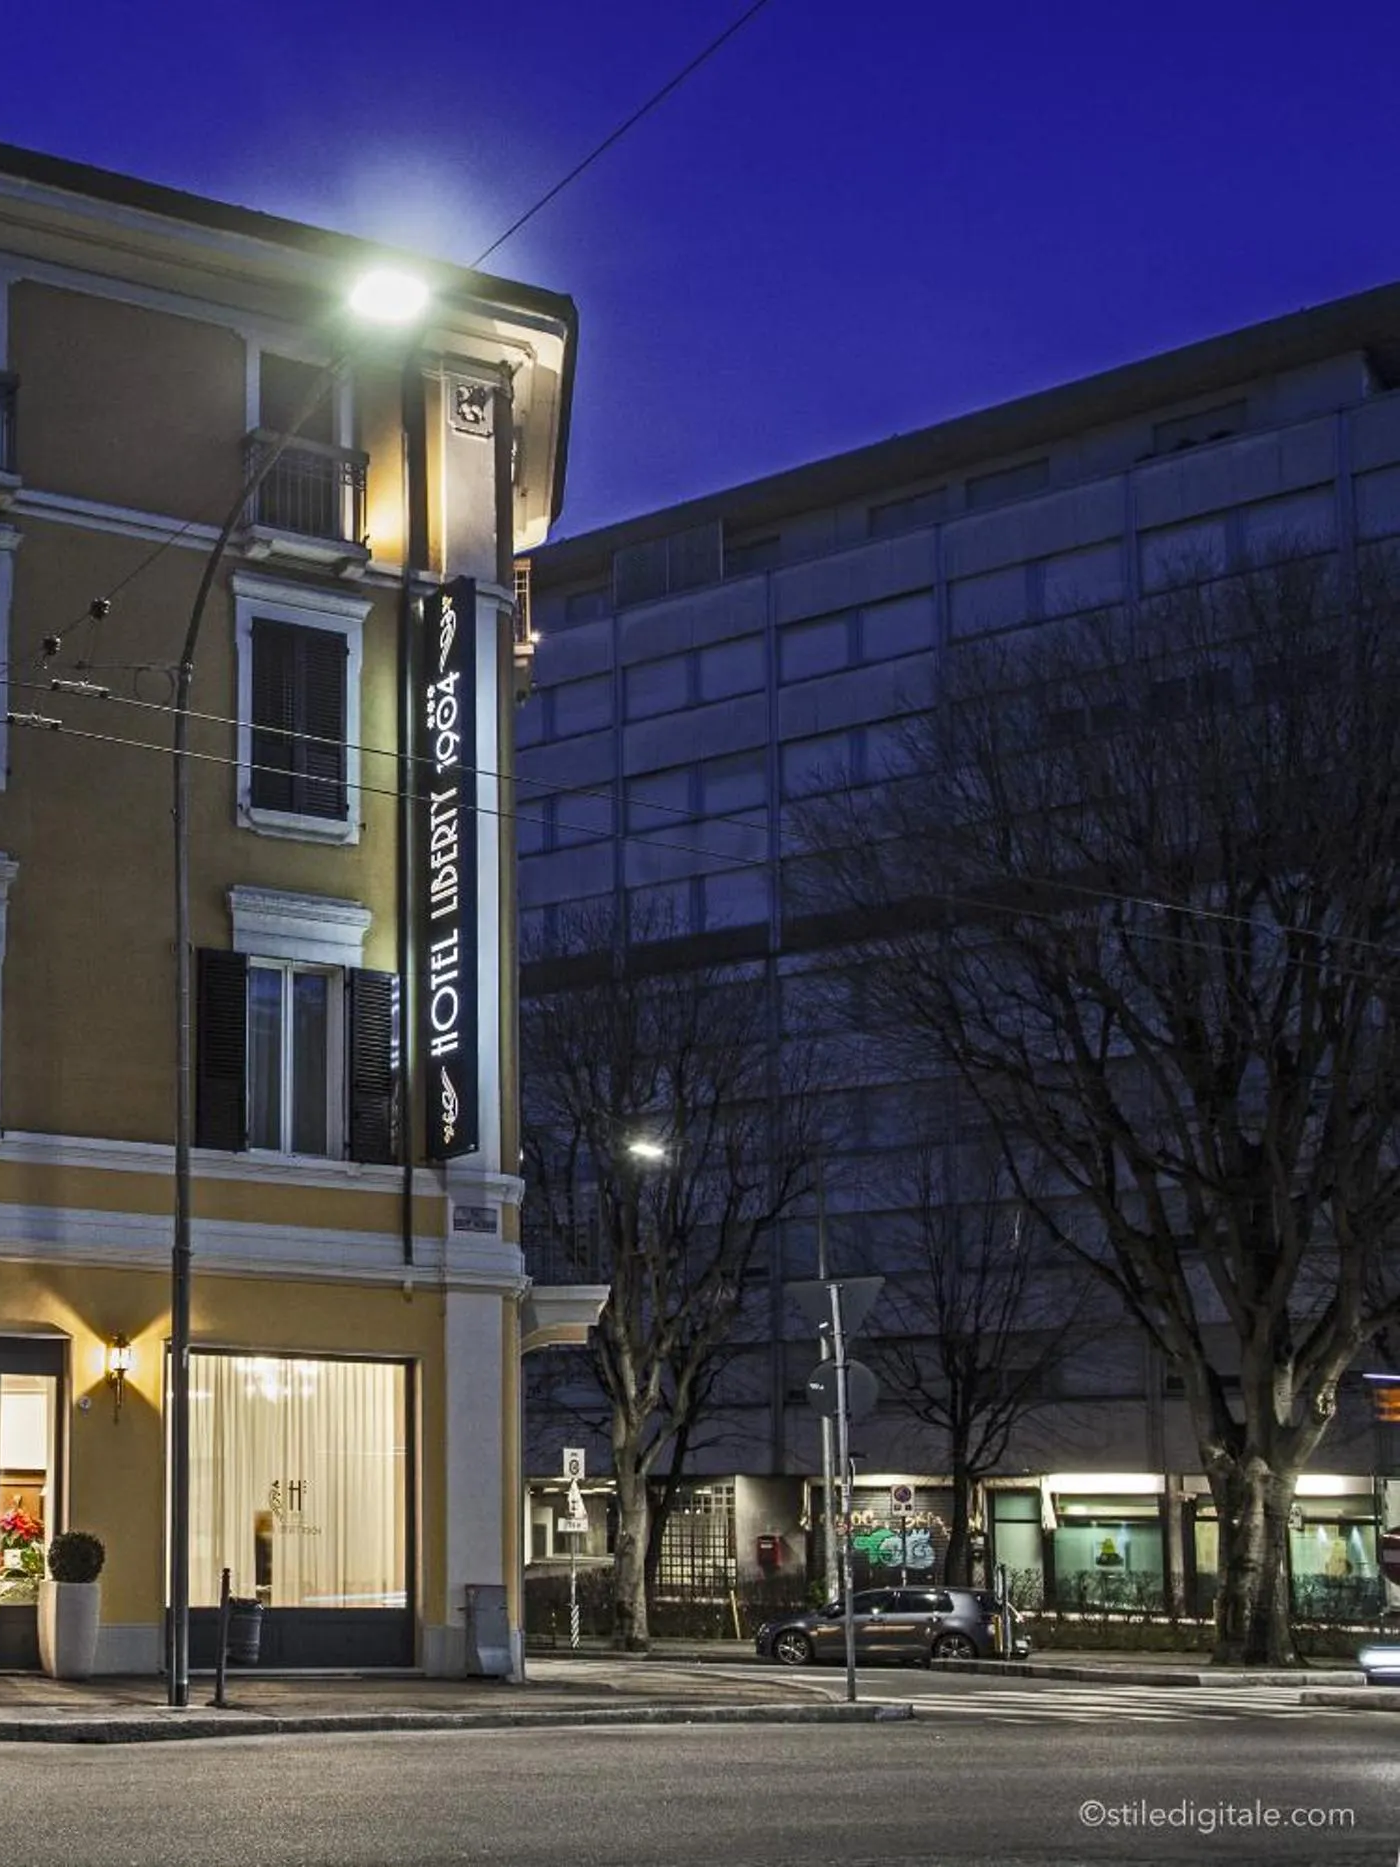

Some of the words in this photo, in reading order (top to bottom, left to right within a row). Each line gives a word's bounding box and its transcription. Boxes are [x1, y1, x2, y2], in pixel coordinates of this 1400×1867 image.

[435, 671, 461, 775] 1904
[430, 786, 458, 920] LIBERTY
[430, 928, 458, 1057] HOTEL
